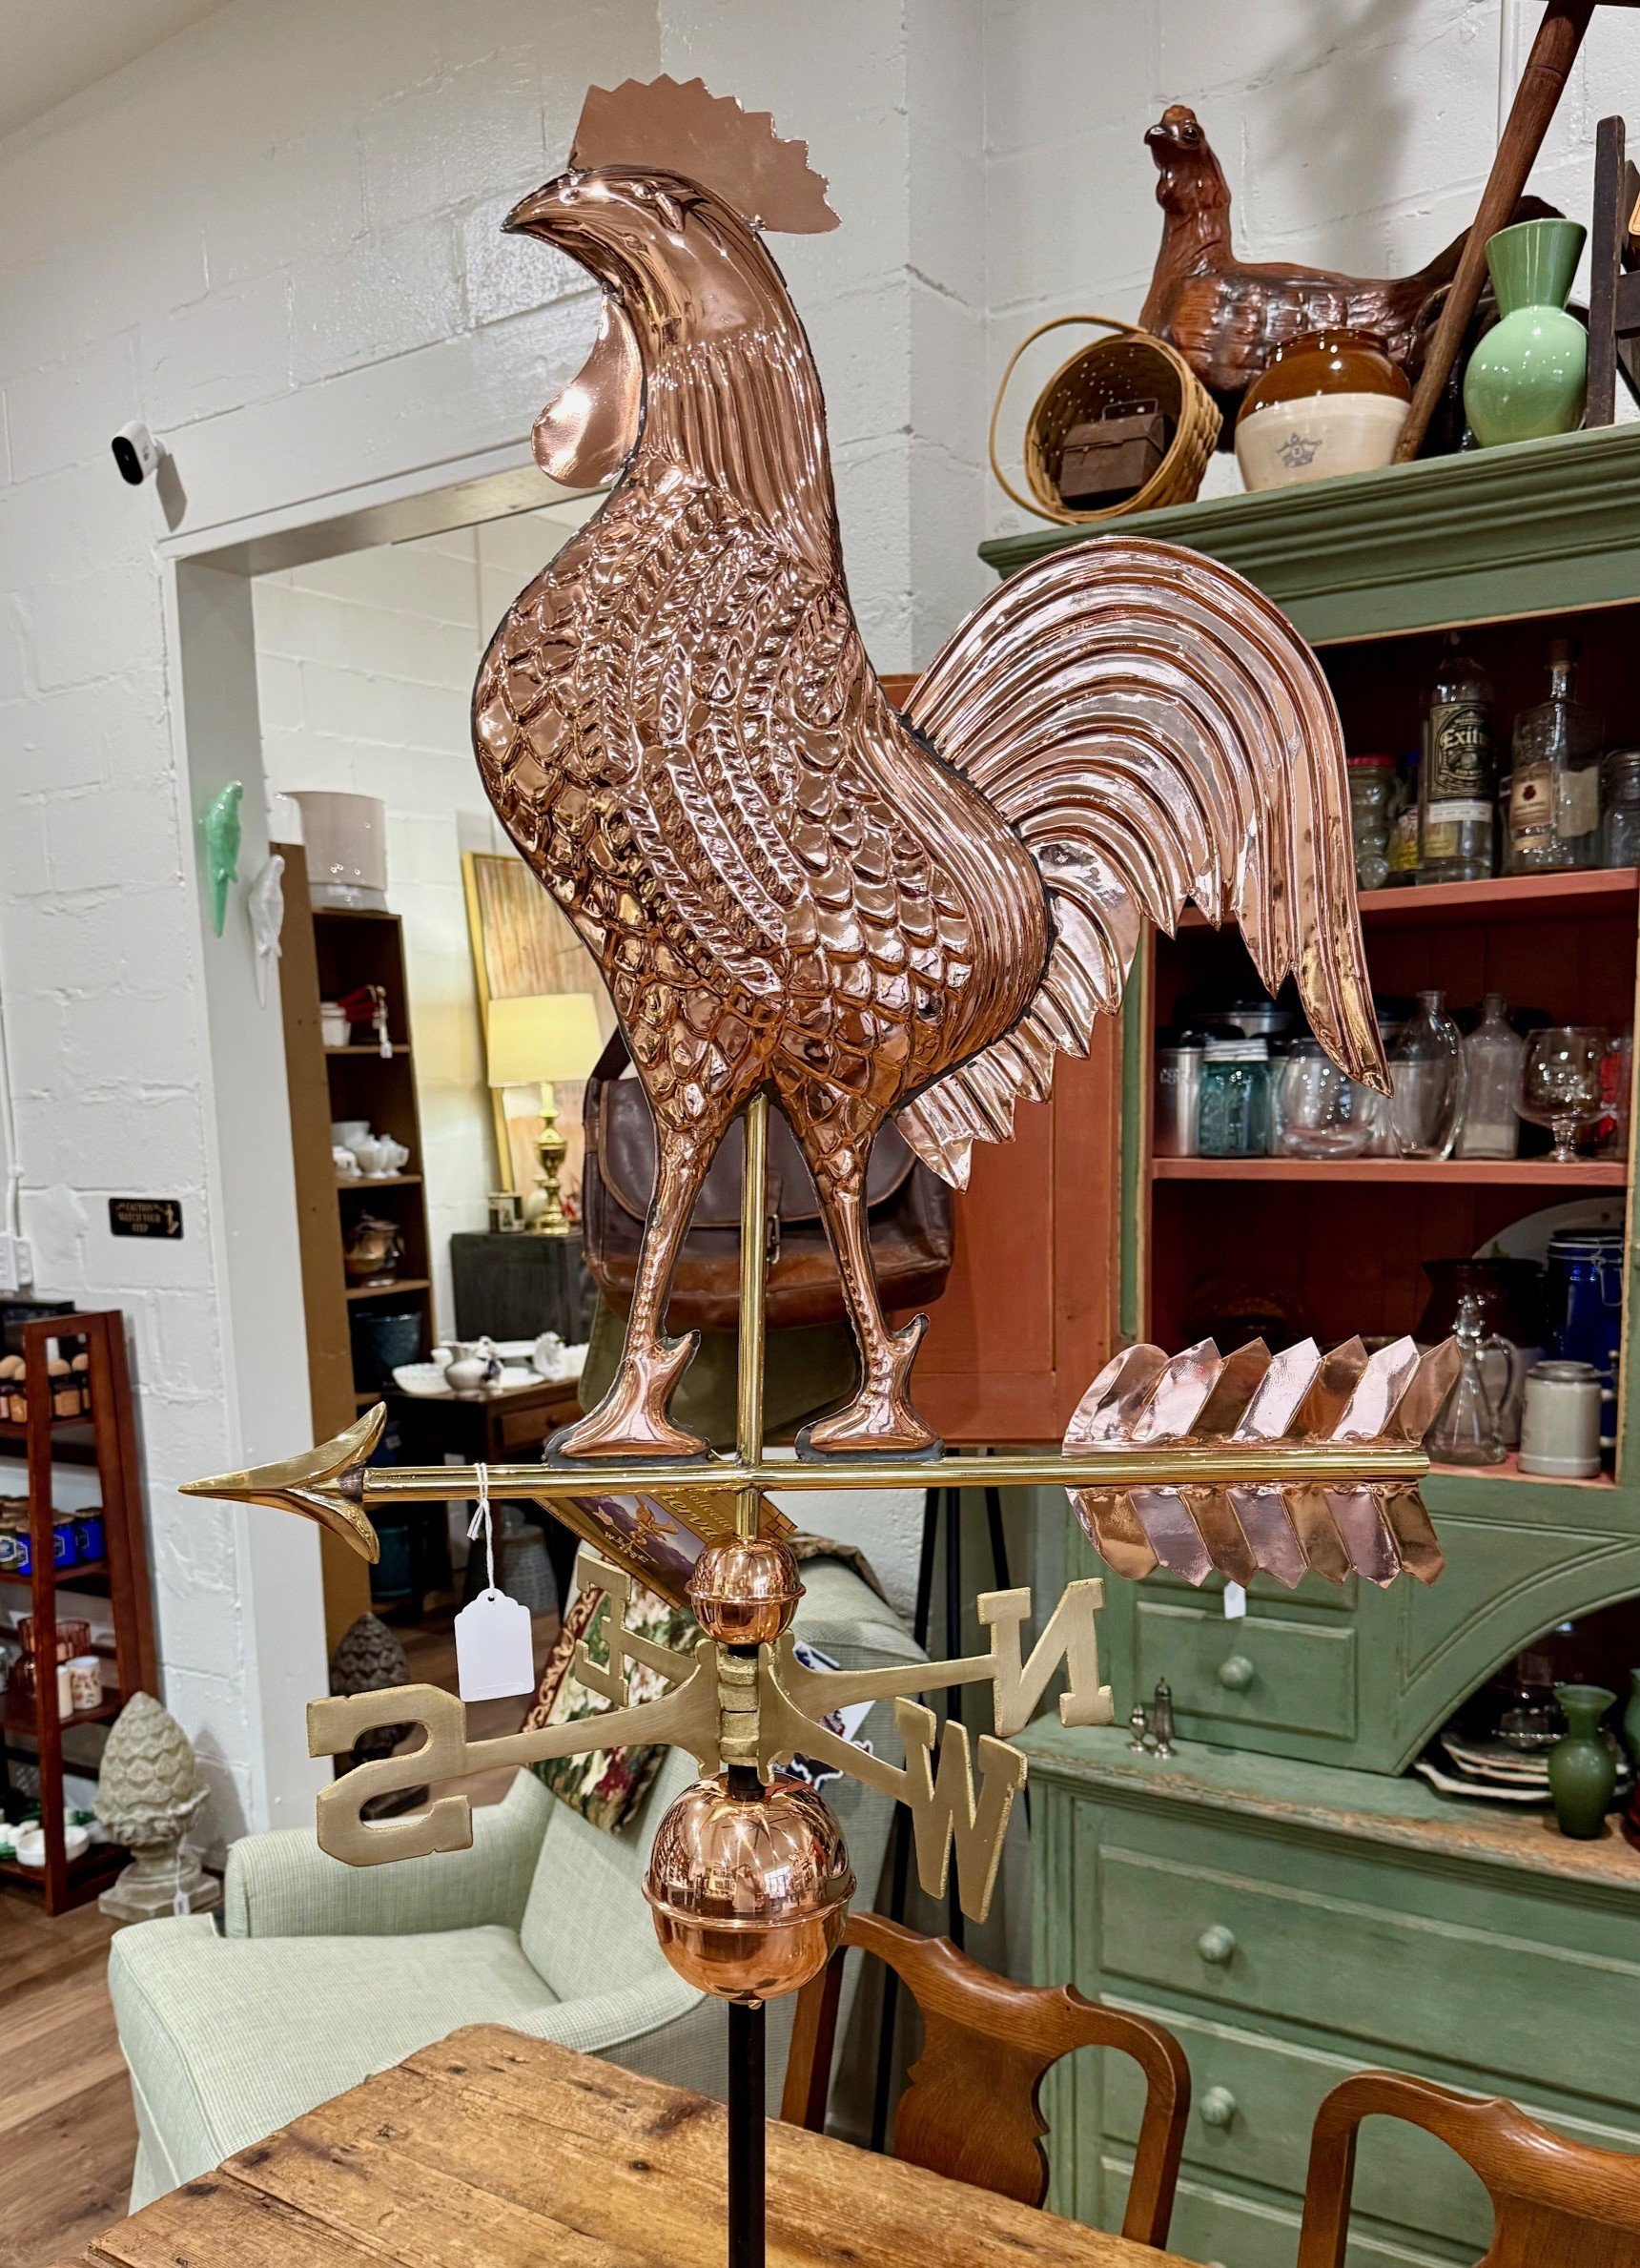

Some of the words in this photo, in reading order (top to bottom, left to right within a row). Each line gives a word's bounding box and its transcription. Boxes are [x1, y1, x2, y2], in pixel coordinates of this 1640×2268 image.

[660, 1493, 720, 1539] nerva
[688, 1495, 733, 1530] ollectio
[895, 1696, 1029, 1924] W
